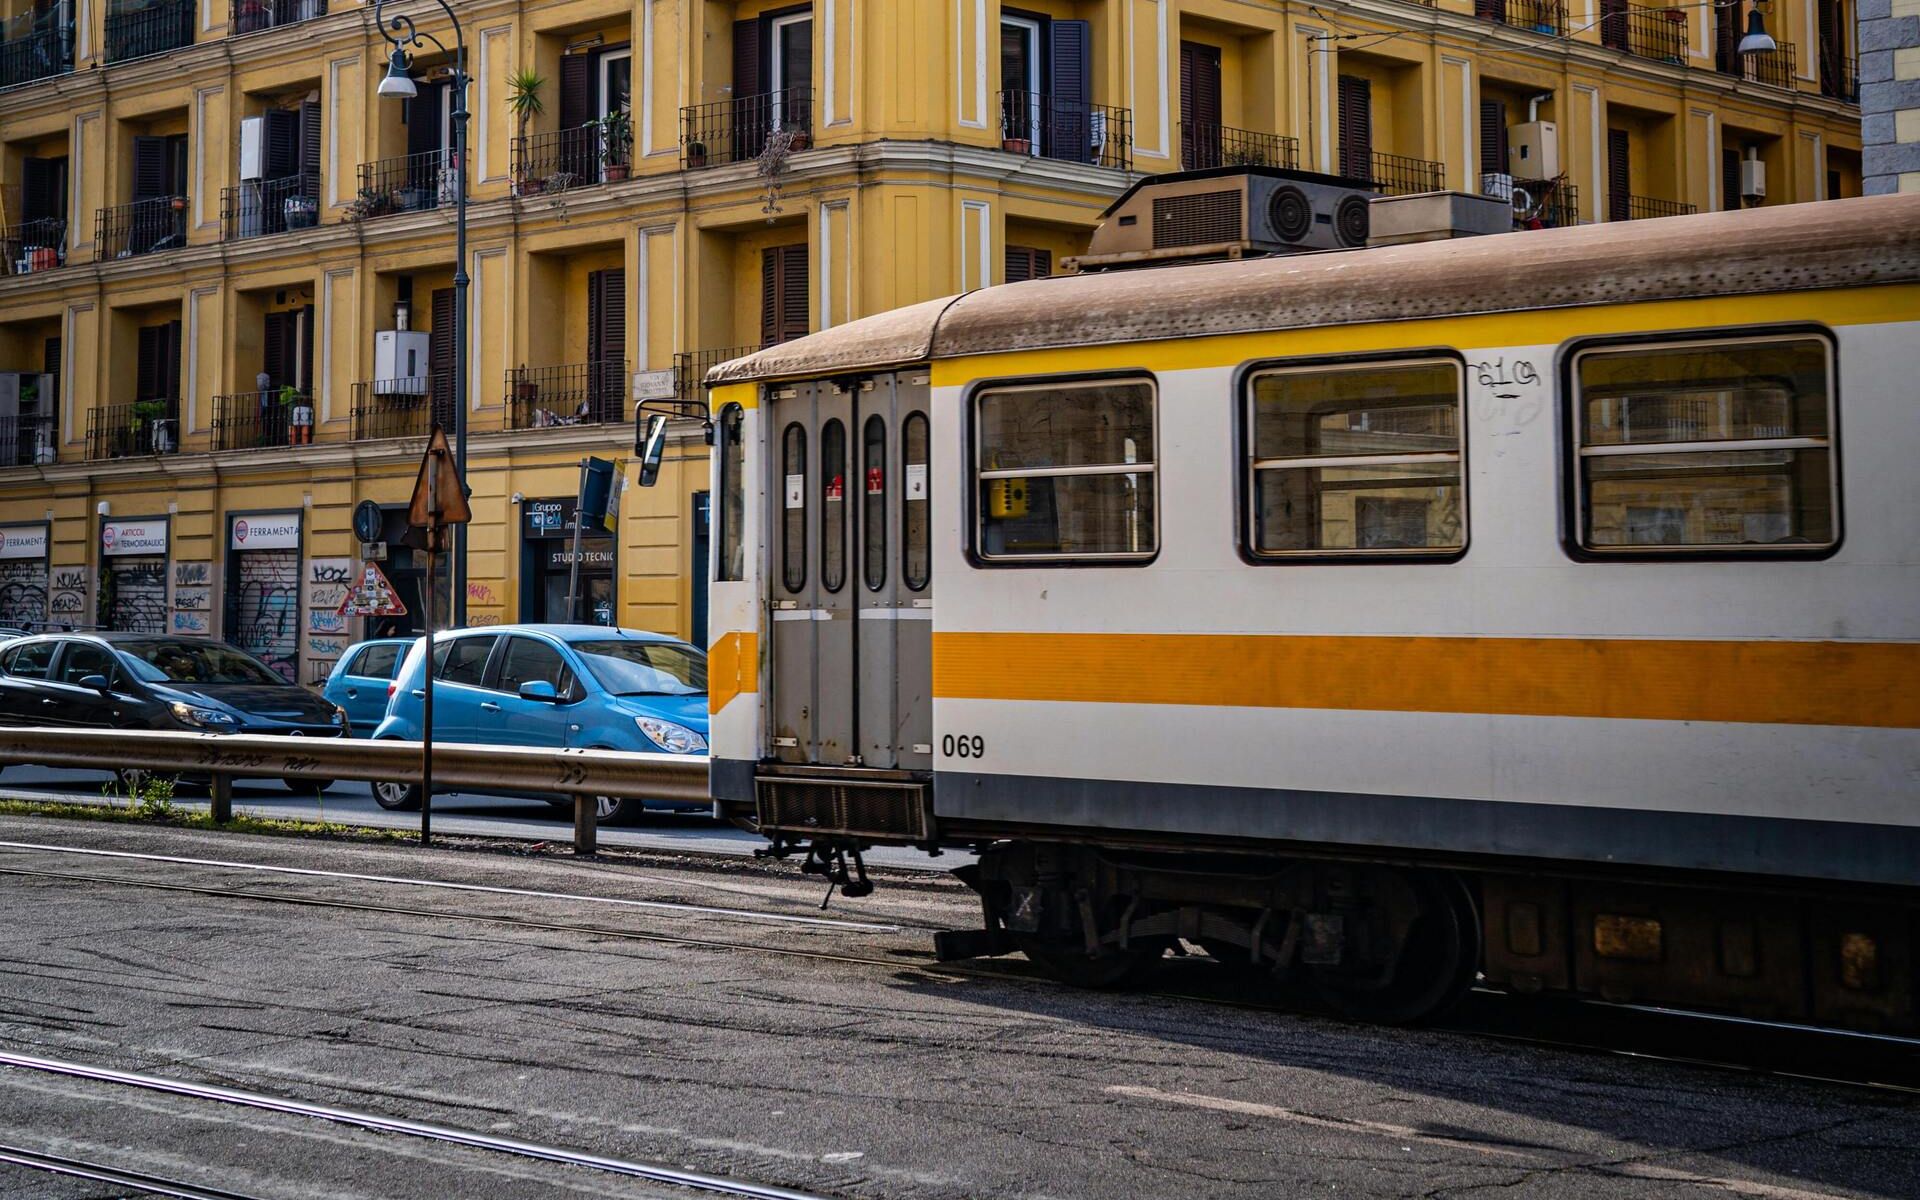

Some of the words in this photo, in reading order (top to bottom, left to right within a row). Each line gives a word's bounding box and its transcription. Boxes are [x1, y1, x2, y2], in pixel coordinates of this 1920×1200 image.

[534, 502, 562, 513] Gruppo
[121, 528, 145, 537] ARTICOLI
[249, 526, 300, 537] FERRAMENTA
[552, 552, 583, 563] STUDO
[942, 733, 985, 758] 069
